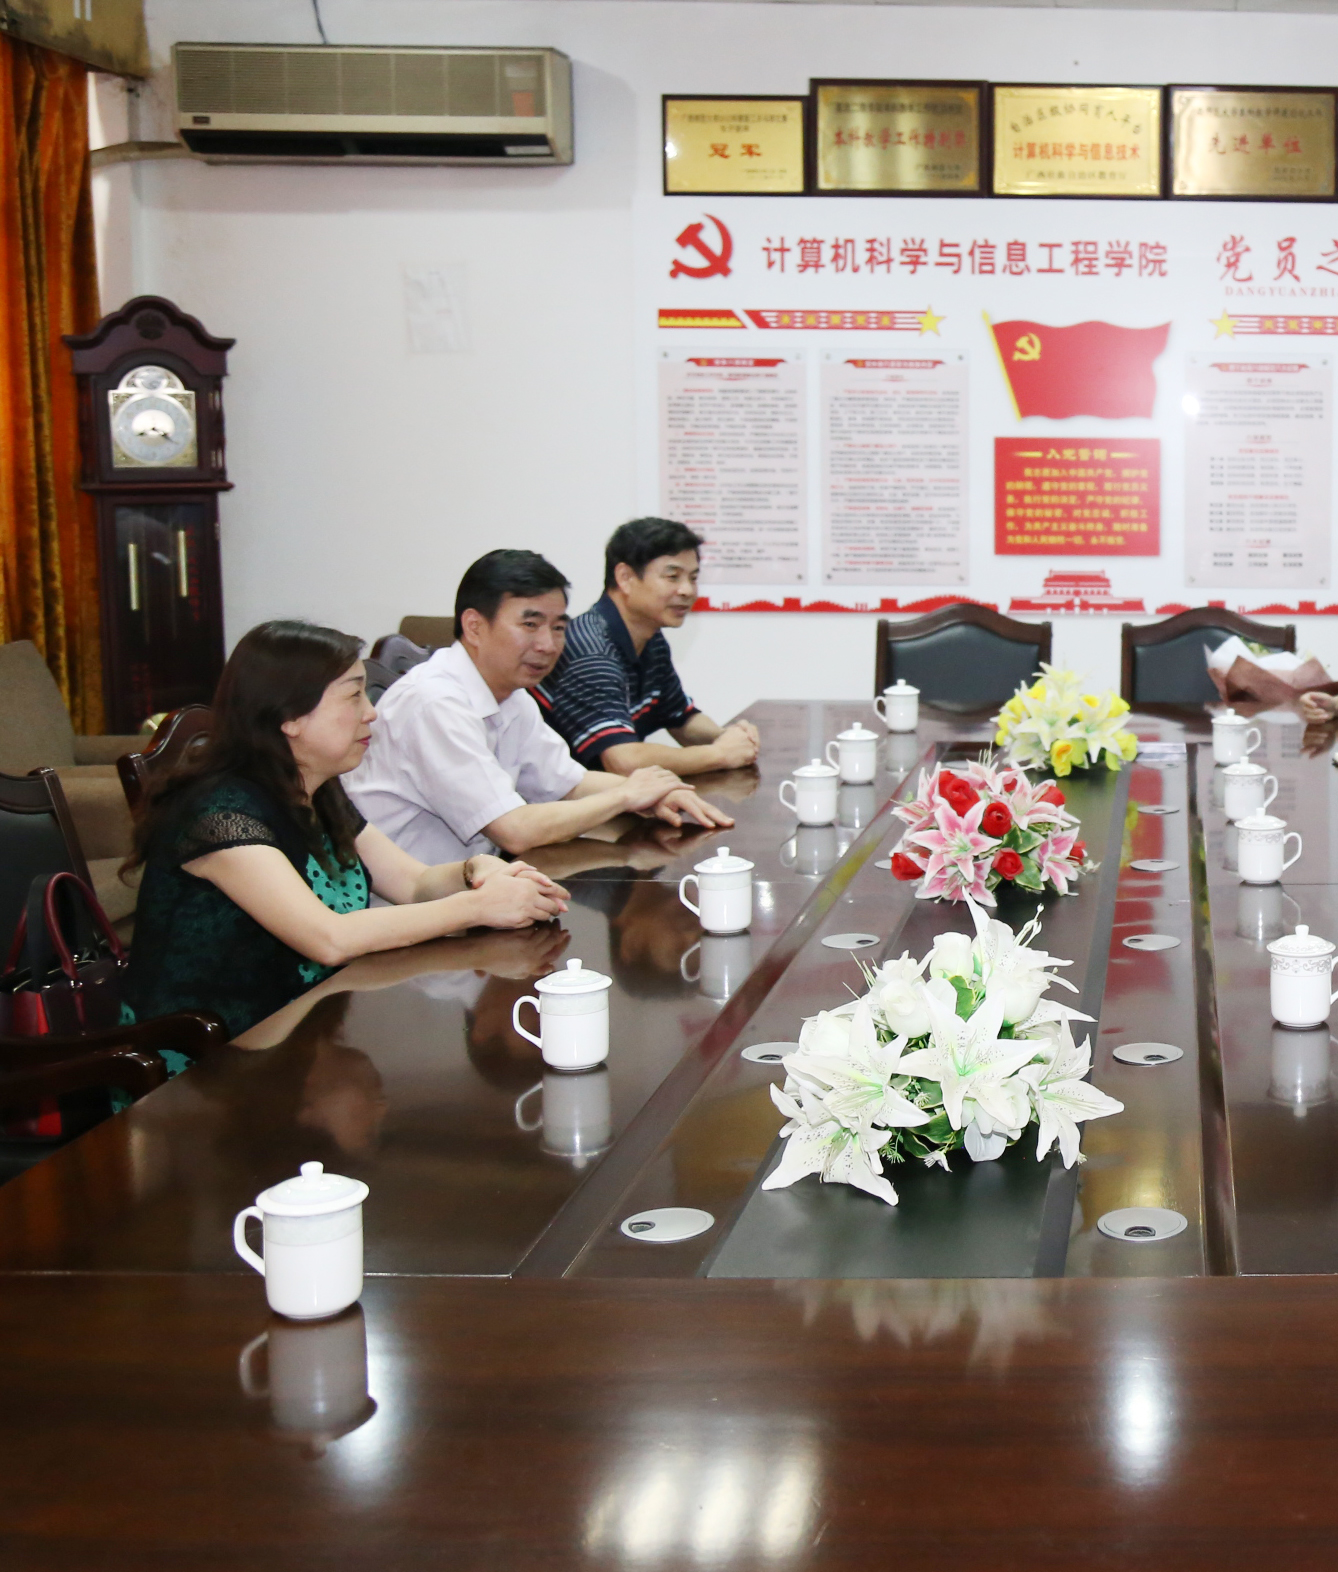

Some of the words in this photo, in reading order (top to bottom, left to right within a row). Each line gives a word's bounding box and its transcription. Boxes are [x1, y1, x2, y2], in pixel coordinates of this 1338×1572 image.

[1012, 142, 1140, 161] 计算机科学与信息技术
[1208, 132, 1303, 155] 先进单位
[761, 236, 1169, 278] 计算机科学与信息工程学院
[1046, 448, 1107, 461] 入党誓词
